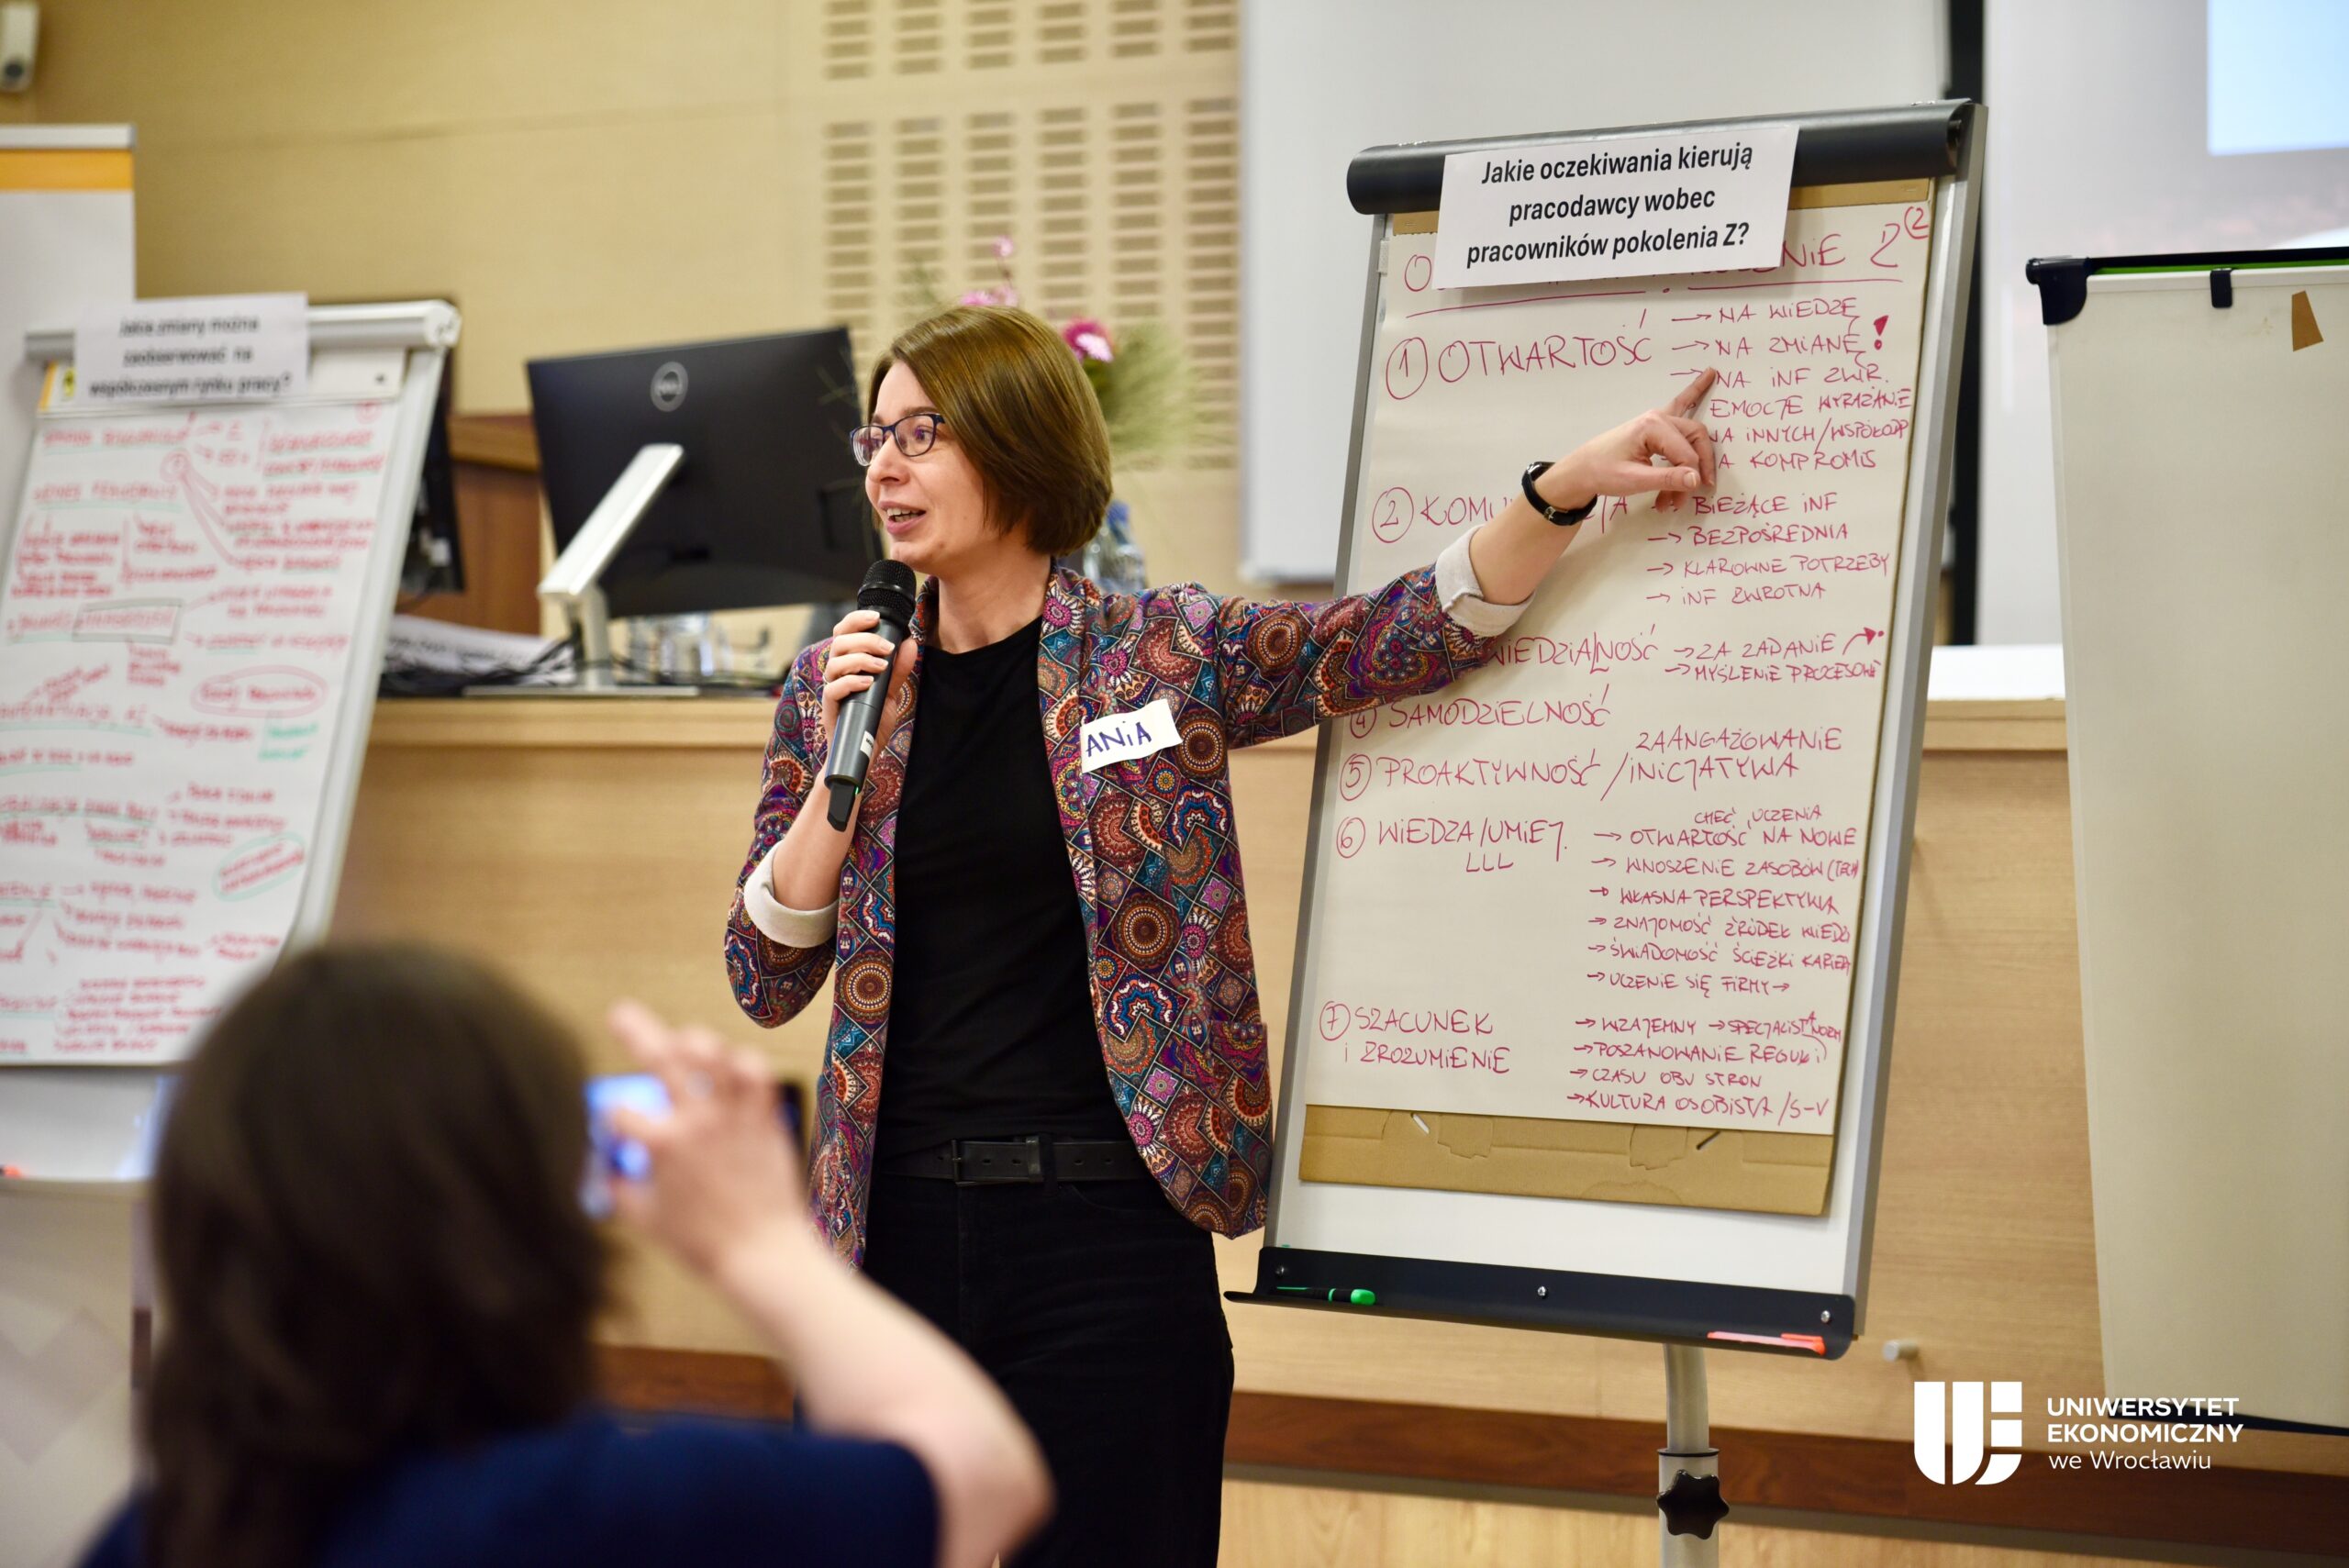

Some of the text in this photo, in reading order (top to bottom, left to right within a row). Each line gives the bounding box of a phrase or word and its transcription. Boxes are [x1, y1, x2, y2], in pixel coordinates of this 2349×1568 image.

[1481, 142, 1753, 184] Jakie oczekiwania kierują
[1509, 188, 1716, 227] pracodawcy wobec
[1466, 221, 1750, 269] pracowników pokolenia Z?
[1719, 303, 1757, 324] NA
[1715, 336, 1753, 360] NA
[1716, 370, 1752, 389] NA
[1684, 552, 1890, 578] KLAROWNE POTRZEBY
[1731, 581, 1827, 605] ZWROTNA
[1696, 641, 1732, 662] ZA
[1763, 826, 1793, 844] NA
[1799, 827, 1857, 847] NOWE
[1693, 888, 1840, 915] PERSPEKTYWA
[1354, 1006, 1494, 1036] SZACUNEK
[1705, 1073, 1762, 1088] STRON
[1585, 1089, 1666, 1112] KULTURA
